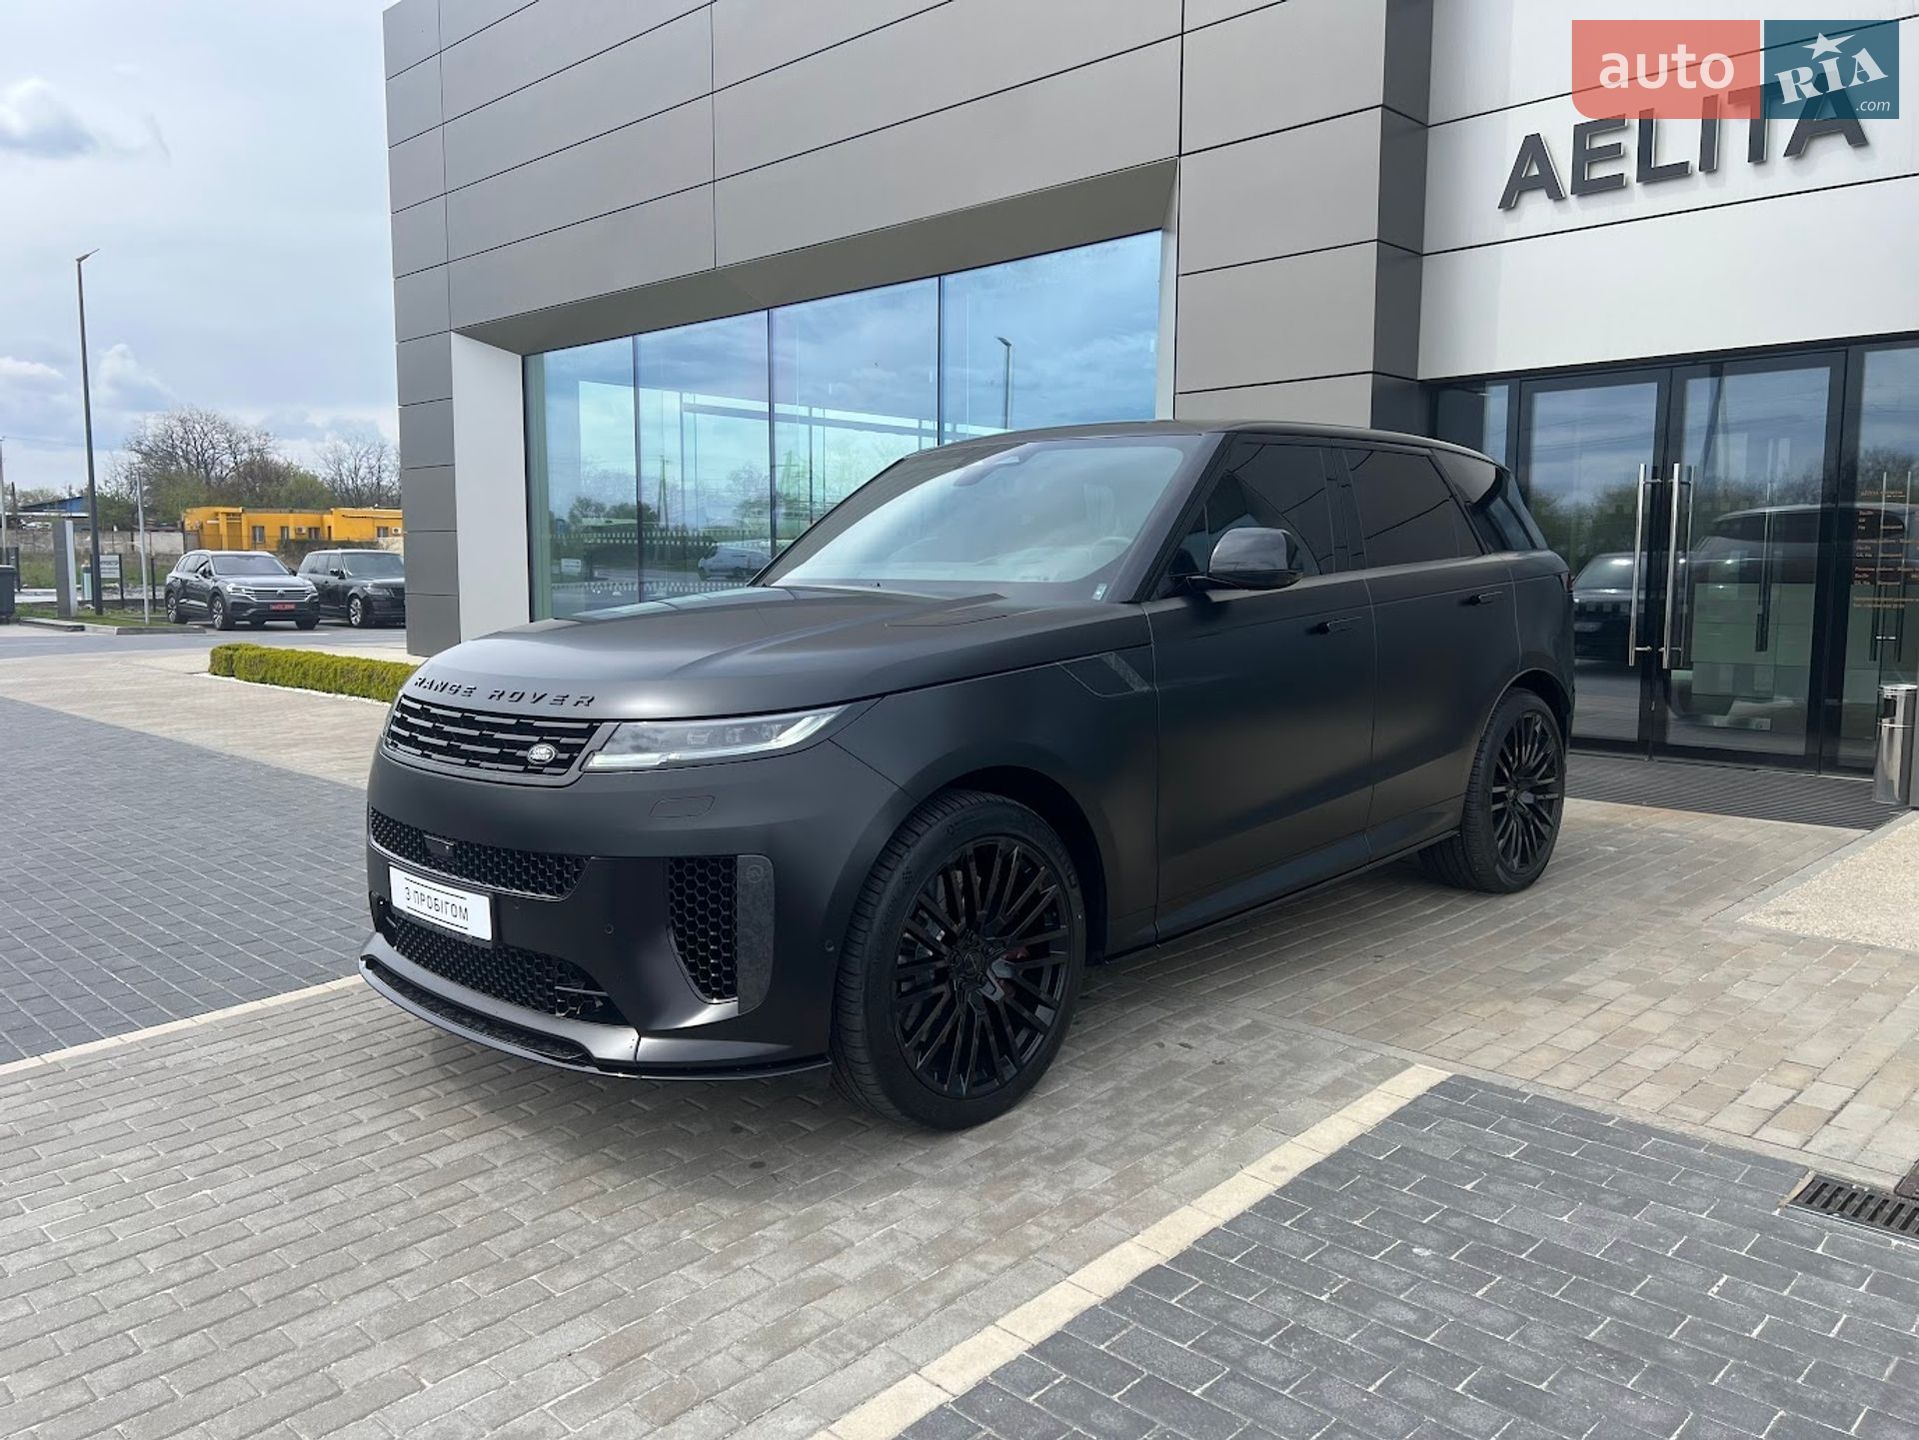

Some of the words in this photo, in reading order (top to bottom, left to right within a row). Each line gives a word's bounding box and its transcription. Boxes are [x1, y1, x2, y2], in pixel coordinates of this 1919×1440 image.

[1498, 72, 1870, 210] AELITA
[414, 677, 477, 698] RANGE
[488, 689, 595, 707] ROVER
